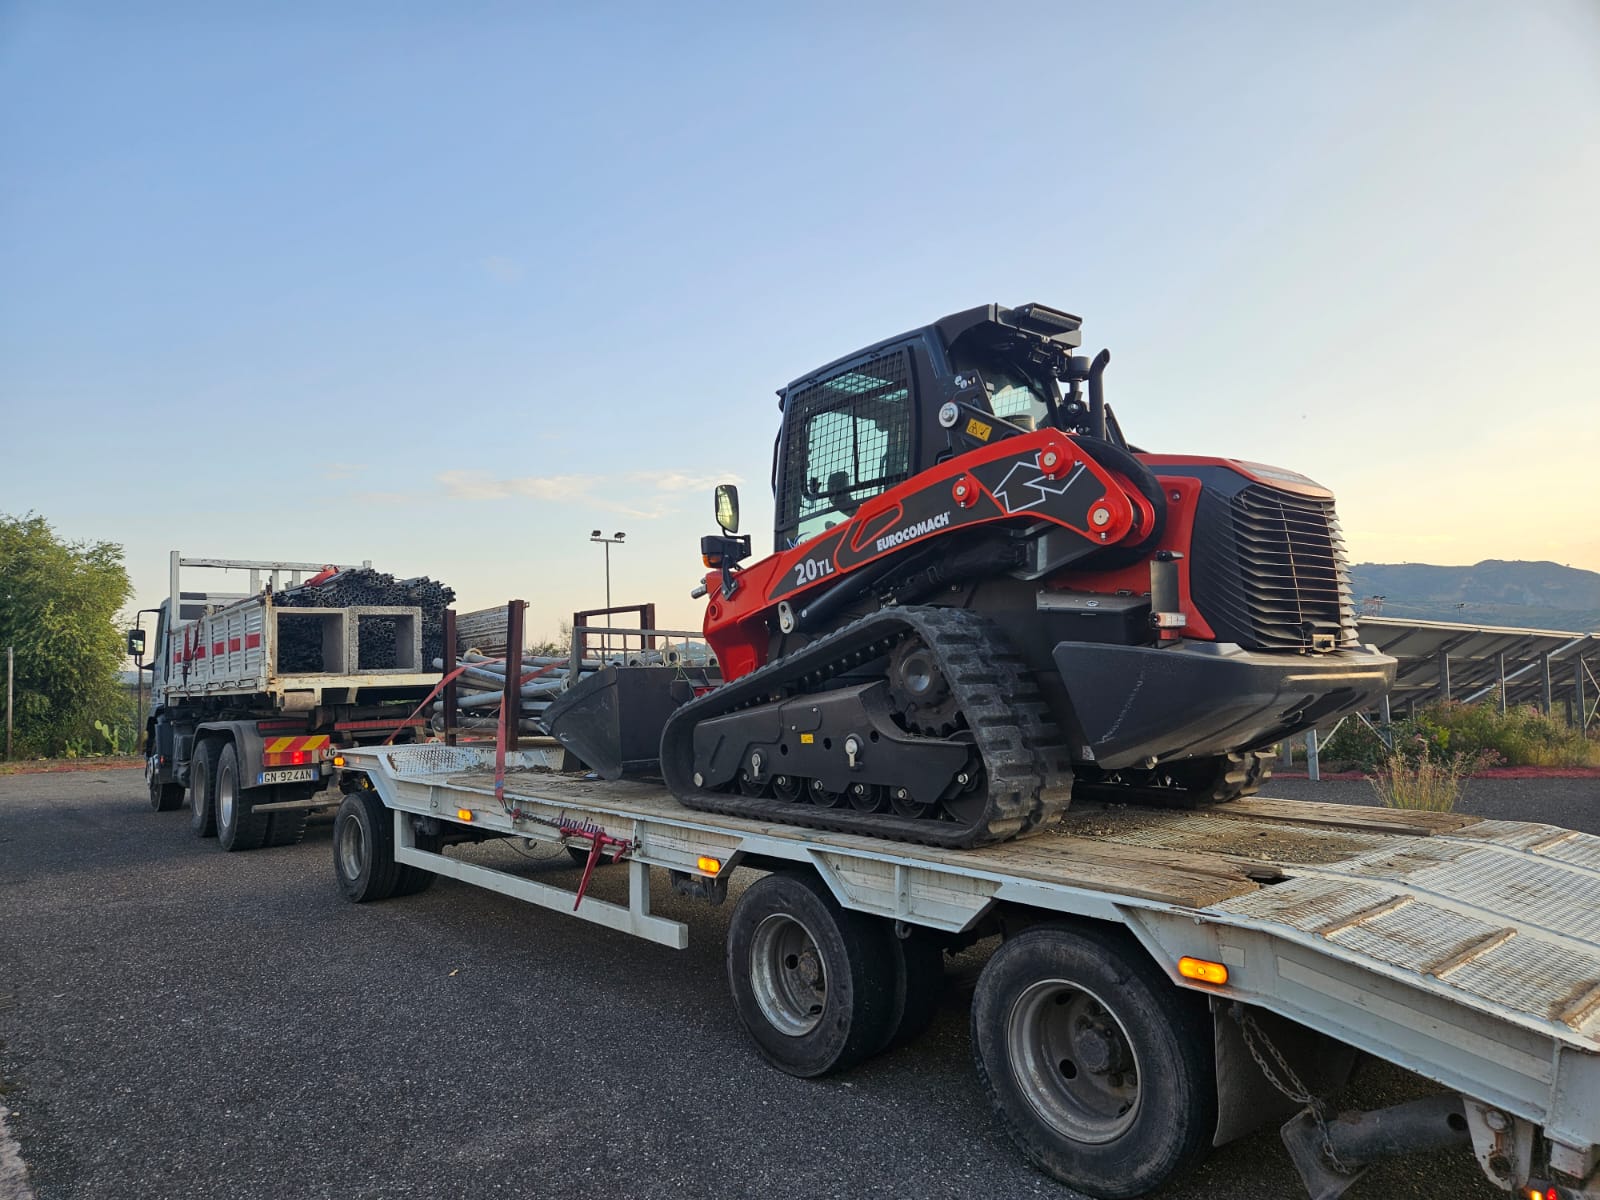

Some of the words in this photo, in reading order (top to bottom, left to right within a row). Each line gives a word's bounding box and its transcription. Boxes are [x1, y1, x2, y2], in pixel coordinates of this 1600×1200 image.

[876, 512, 950, 552] EUROCOMACH
[794, 558, 834, 586] 20TL
[264, 772, 277, 783] GN
[280, 770, 311, 781] 924AN
